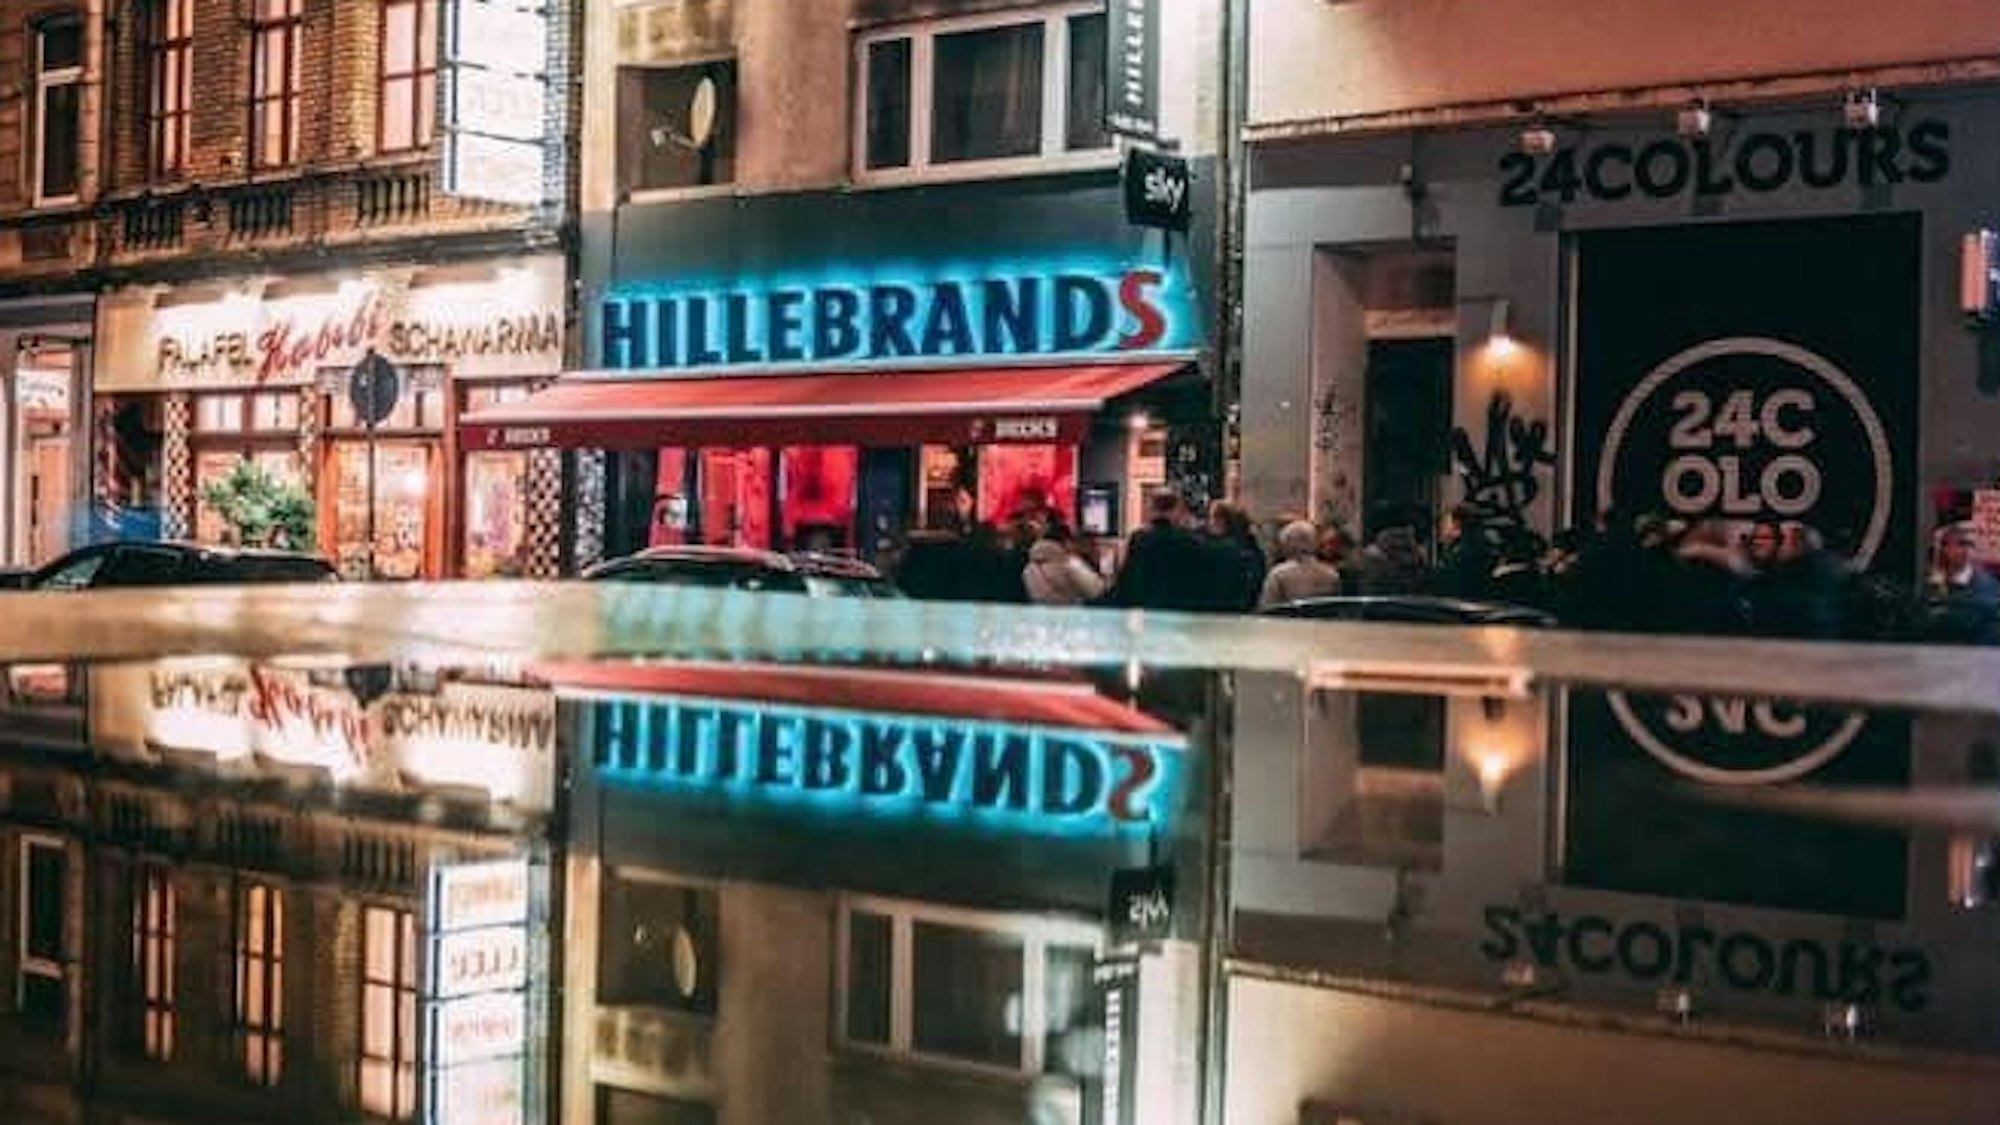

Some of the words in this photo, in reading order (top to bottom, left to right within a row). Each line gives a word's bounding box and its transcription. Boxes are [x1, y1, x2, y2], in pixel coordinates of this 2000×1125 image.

[1145, 167, 1184, 212] sky
[1500, 121, 1948, 205] 24COLOURS
[602, 271, 1166, 368] HILLEBRANDS
[157, 332, 254, 373] FALAFEL
[1669, 388, 1816, 448] 24C
[1663, 455, 1823, 514] OLO
